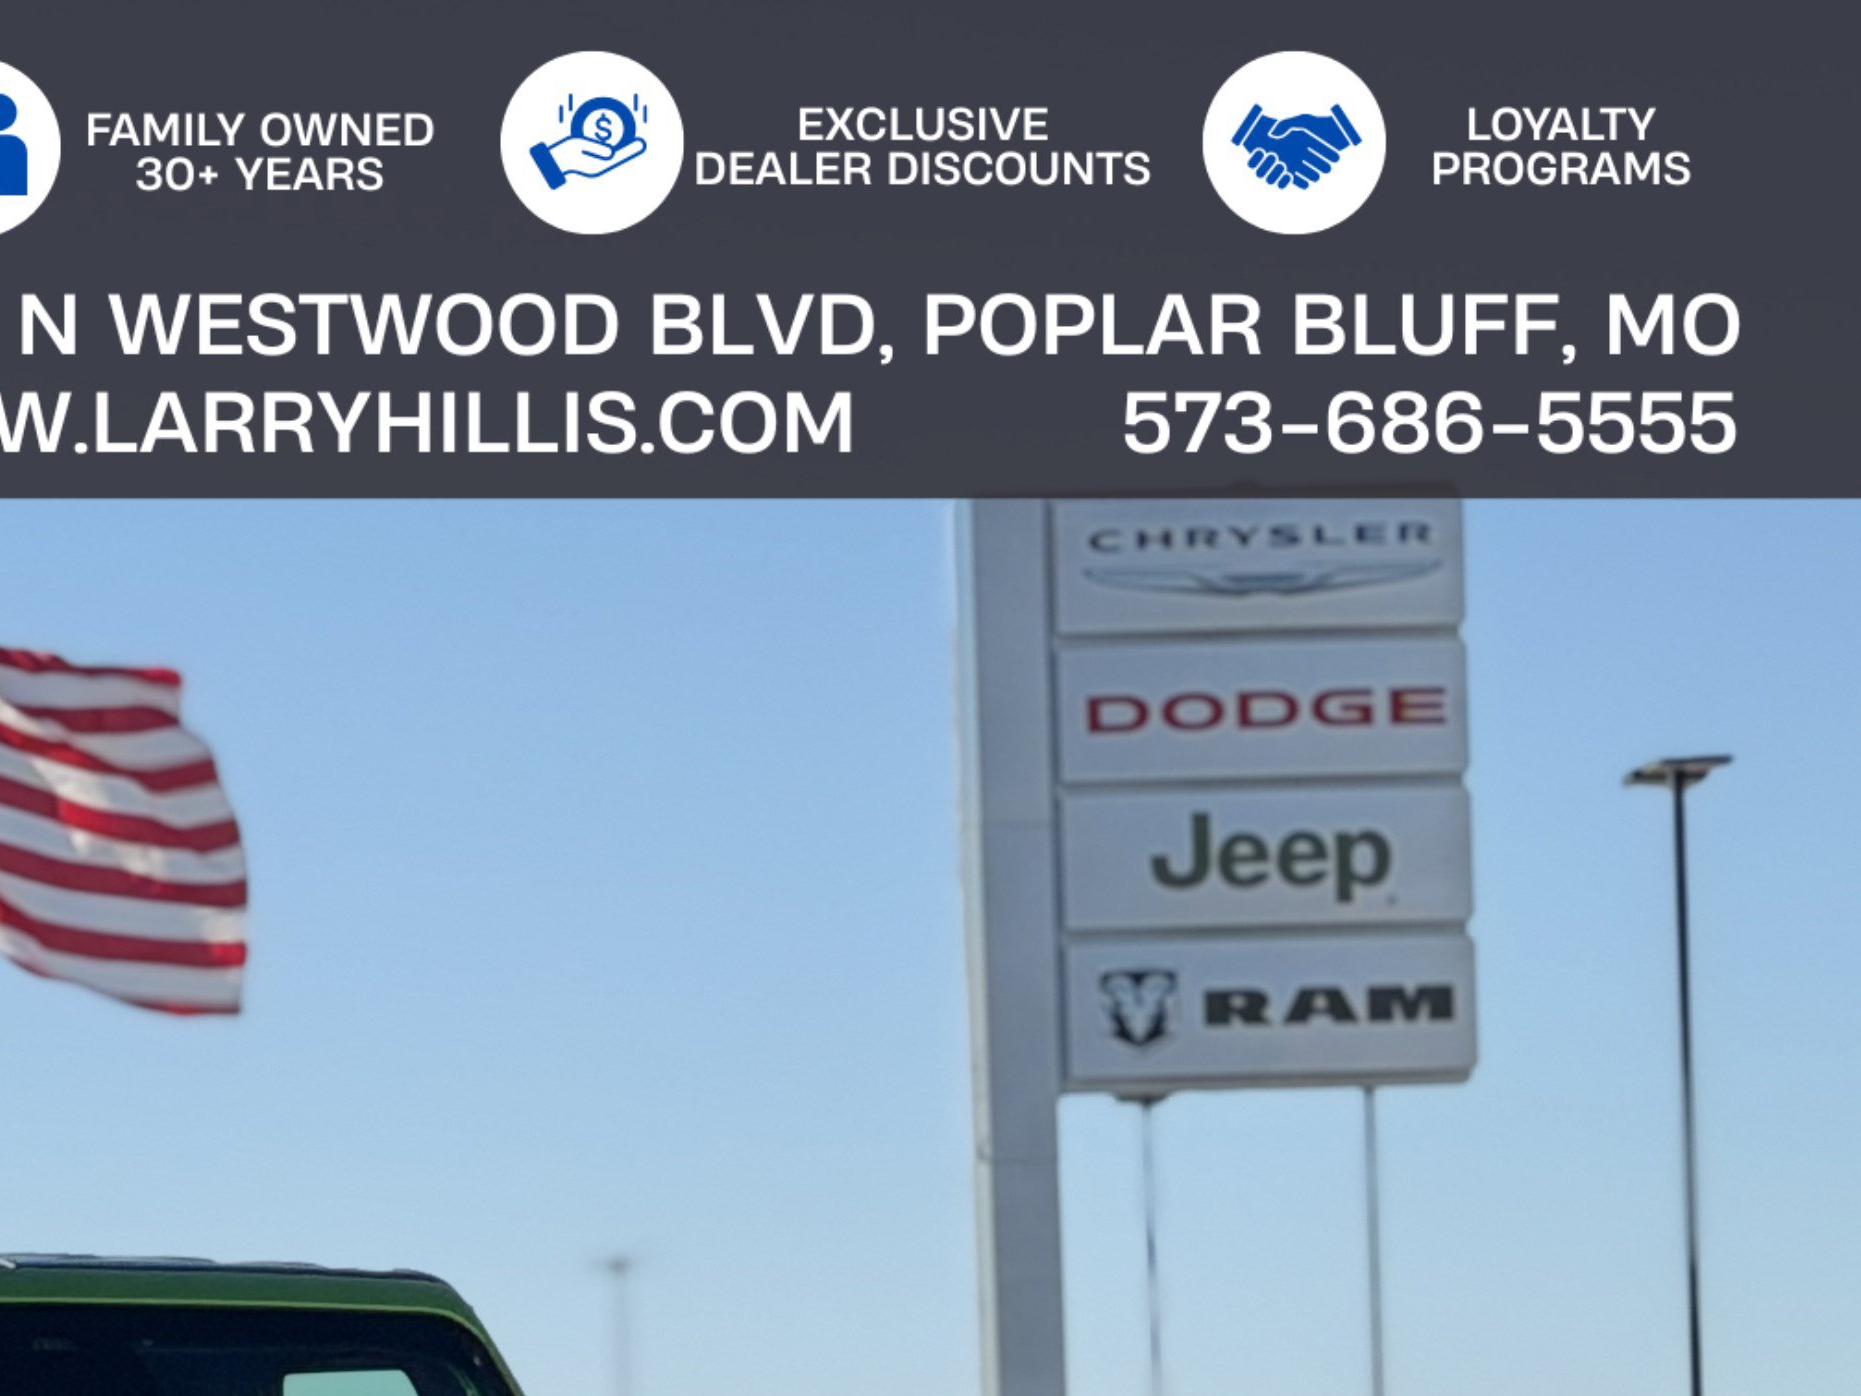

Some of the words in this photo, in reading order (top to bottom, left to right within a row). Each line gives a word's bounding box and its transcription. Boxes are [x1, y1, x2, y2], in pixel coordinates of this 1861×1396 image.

[1088, 521, 1431, 554] CHRYSLER
[1087, 687, 1447, 734] DODGE
[1151, 811, 1391, 904] Jeep
[1203, 986, 1455, 1027] RAM
